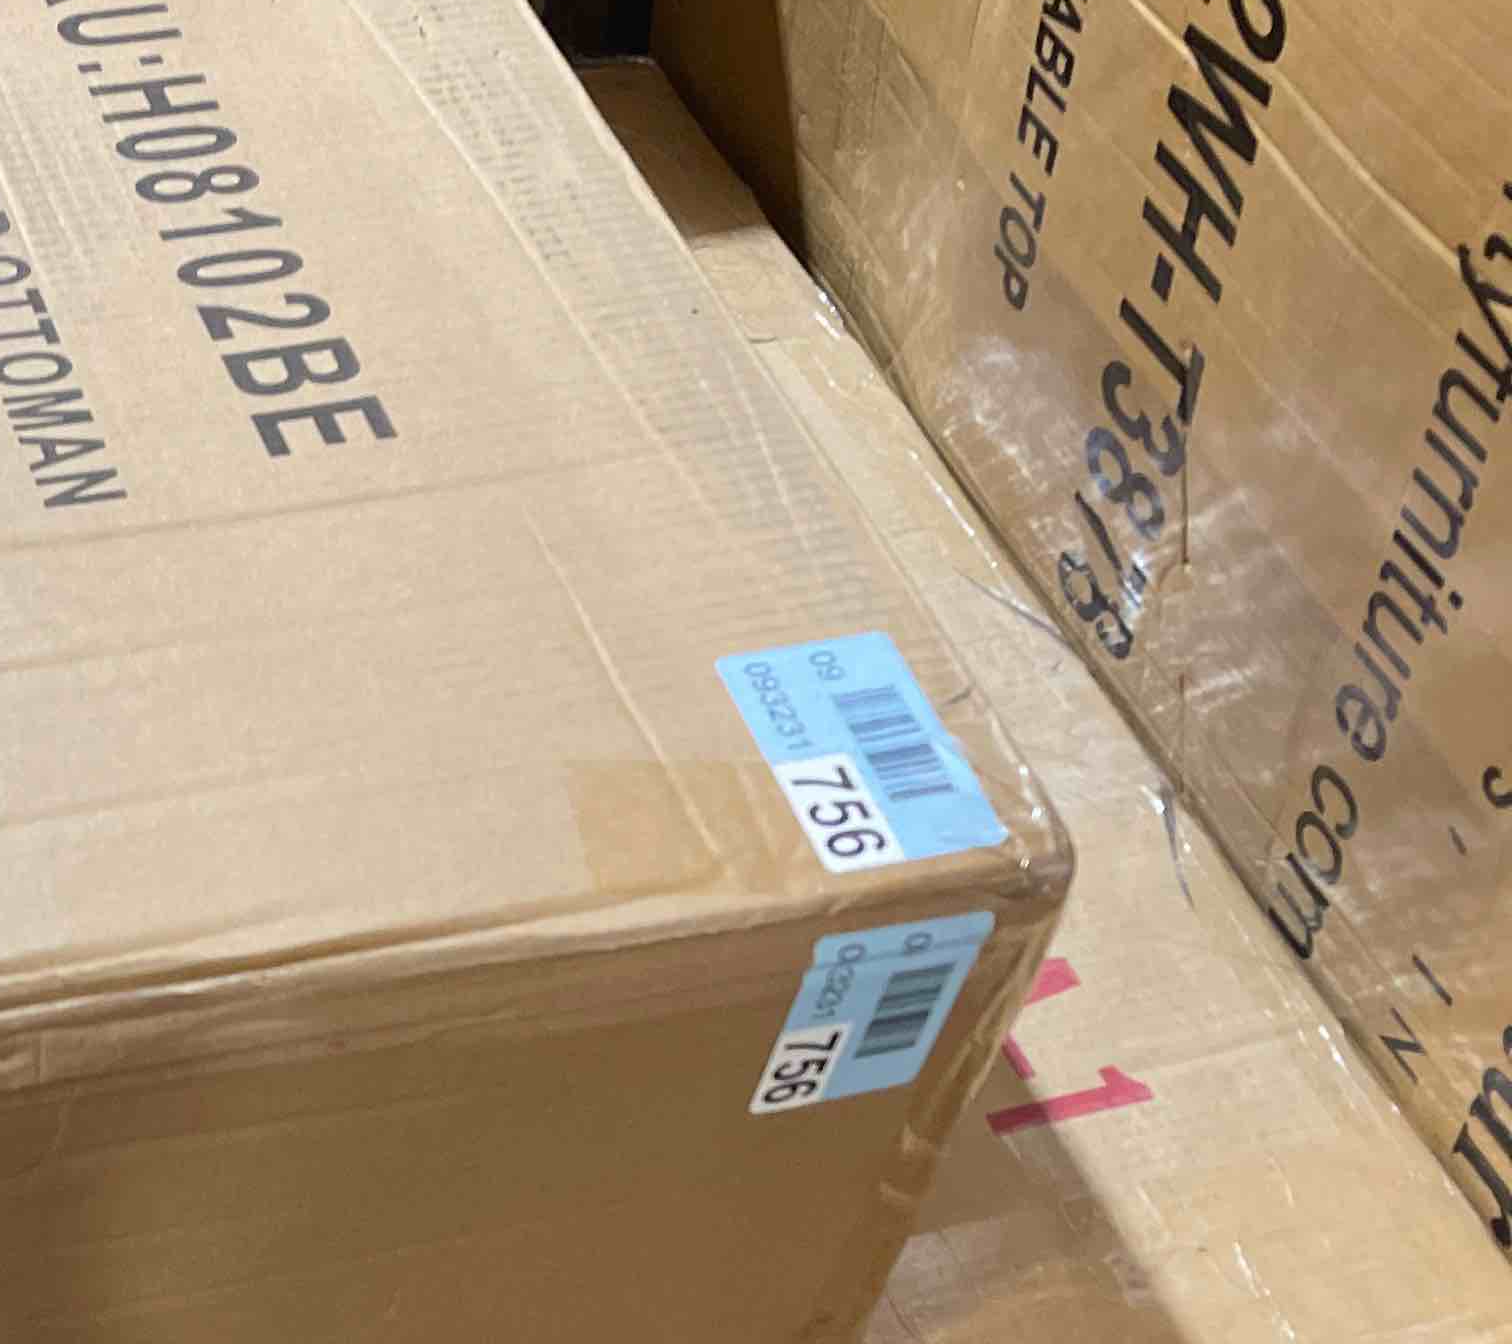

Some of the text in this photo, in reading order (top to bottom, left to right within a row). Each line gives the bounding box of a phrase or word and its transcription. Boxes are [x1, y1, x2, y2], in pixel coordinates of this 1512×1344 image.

[999, 171, 1046, 313] TOP
[808, 648, 846, 683] 09
[791, 764, 887, 858] 756
[763, 1028, 840, 1105] 756
